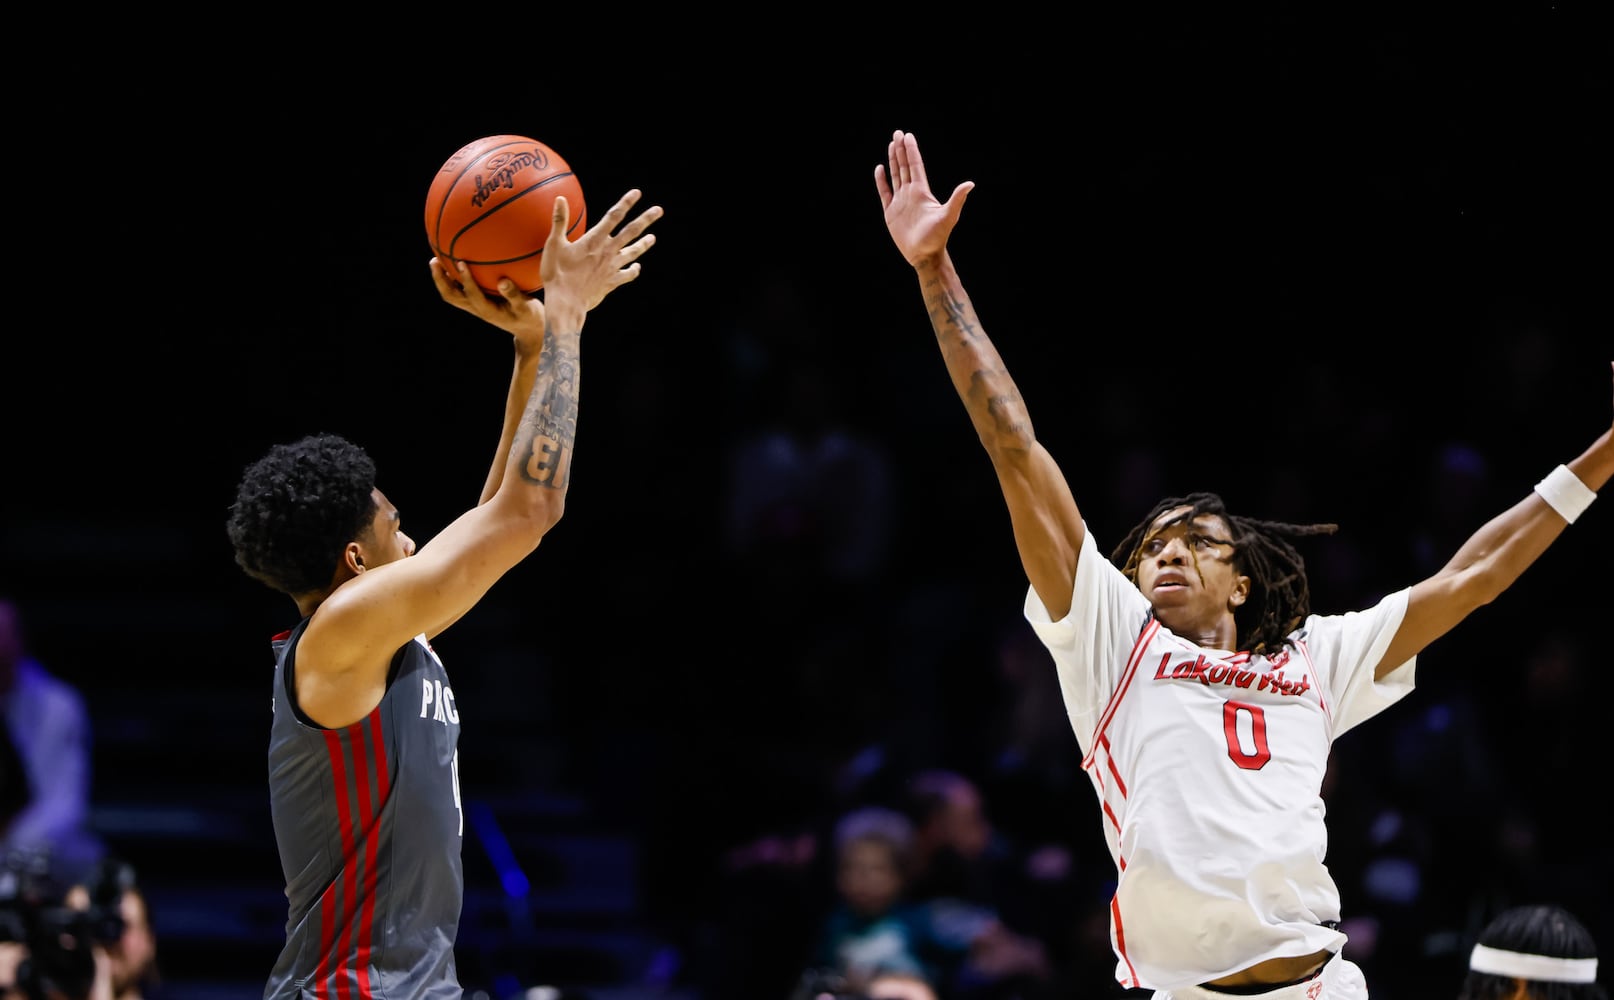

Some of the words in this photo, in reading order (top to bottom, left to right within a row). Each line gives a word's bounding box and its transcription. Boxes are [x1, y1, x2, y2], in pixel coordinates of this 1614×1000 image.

[472, 148, 548, 207] Rawlings
[1154, 652, 1257, 688] Lakota
[1223, 700, 1271, 770] 0
